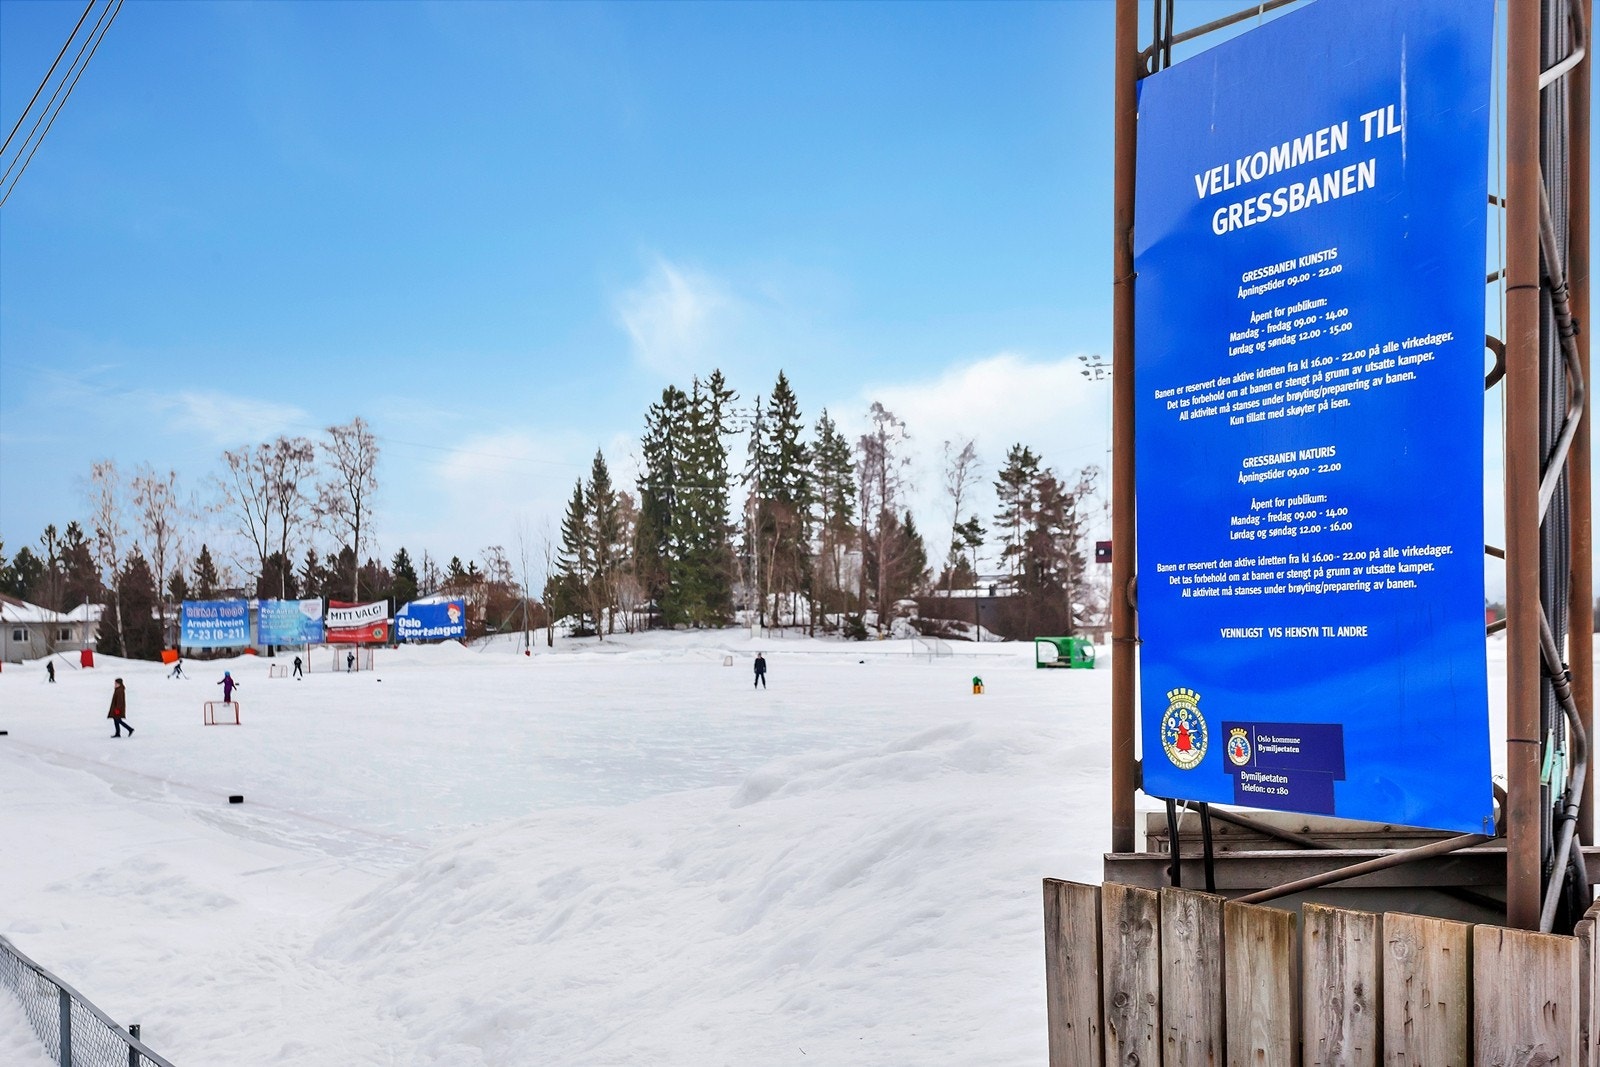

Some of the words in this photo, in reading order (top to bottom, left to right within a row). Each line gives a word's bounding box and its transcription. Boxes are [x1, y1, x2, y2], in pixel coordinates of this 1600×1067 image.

[1194, 121, 1348, 199] VELKOMMEN
[1360, 104, 1402, 143] TIL
[1212, 158, 1375, 235] GRESSBANEN
[1242, 259, 1296, 282] GRESSBANEN
[1299, 248, 1338, 268] KUNSTIS
[1238, 279, 1285, 299] Åpningstider
[1287, 273, 1310, 286] 09.00
[1318, 264, 1342, 277] 22.00
[1250, 310, 1272, 324] Åpent
[1274, 307, 1286, 317] for
[1287, 298, 1327, 317] publikum:
[1230, 328, 1260, 342] Mandag
[1267, 321, 1292, 333] fredag
[1294, 315, 1317, 328] 09.00
[1325, 308, 1348, 321] 14.00
[1229, 344, 1254, 356] Lørdag
[1256, 341, 1266, 351] og
[1268, 334, 1296, 348] søndag
[1299, 329, 1321, 341] 12.00
[1329, 322, 1352, 335] 15.00
[1155, 389, 1175, 399] Banen
[1185, 379, 1216, 393] reservert
[1217, 376, 1230, 386] den
[1232, 372, 1254, 383] aktive
[1256, 366, 1285, 378] idretten
[1287, 362, 1298, 372] fra
[1300, 359, 1308, 370] kl
[1311, 356, 1333, 368] 16.00
[1342, 350, 1366, 362] 22.00
[1369, 344, 1380, 359] på
[1382, 341, 1399, 353] alle
[1402, 332, 1454, 349] virkedager.
[1167, 400, 1178, 410] Det
[1180, 399, 1190, 407] tas
[1192, 390, 1225, 405] forbehold
[1226, 390, 1238, 398] om
[1240, 386, 1248, 396] at
[1250, 383, 1272, 394] banen
[1275, 381, 1283, 389] er
[1285, 374, 1310, 387] stengt
[1312, 370, 1323, 385] på
[1325, 368, 1349, 382] grunn
[1352, 365, 1362, 375] av
[1365, 358, 1395, 372] utsatte
[1398, 352, 1435, 366] kamper.
[1179, 410, 1189, 421] All
[1190, 406, 1218, 419] aktivitet
[1219, 402, 1230, 414] må
[1232, 400, 1260, 411] stanses
[1262, 394, 1284, 406] under
[1286, 379, 1370, 402] brøyting/preparering
[1372, 377, 1383, 386] av
[1386, 372, 1416, 384] banen.
[1230, 416, 1244, 426] Kun
[1246, 411, 1266, 423] tillatt
[1268, 407, 1284, 419] med
[1286, 404, 1316, 416] skøyter
[1318, 399, 1328, 413] på
[1331, 398, 1351, 408] isen.
[1243, 451, 1296, 468] GRESSBANEN
[1299, 446, 1336, 460] NATURIS
[1238, 468, 1285, 484] Åpningstider
[1287, 467, 1310, 478] 09.00
[1318, 463, 1341, 473] 22.00
[1251, 498, 1273, 512] Åpent
[1275, 497, 1286, 507] for
[1288, 494, 1327, 508] publikum:
[1231, 514, 1260, 526] Mandag
[1267, 511, 1292, 523] fredag
[1294, 510, 1317, 522] 09.00
[1326, 507, 1348, 518] 14.00
[1230, 529, 1255, 540] Lørdag
[1257, 530, 1267, 539] og
[1269, 525, 1297, 537] søndag
[1299, 525, 1321, 534] 12.00
[1330, 521, 1352, 531] 16.00
[1157, 563, 1177, 572] Banen
[1187, 560, 1217, 570] reservert
[1219, 559, 1232, 568] den
[1234, 557, 1256, 567] aktive
[1258, 556, 1286, 566] idretten
[1289, 554, 1299, 564] fra
[1302, 553, 1310, 563] kl
[1312, 552, 1336, 562] 16.00
[1342, 552, 1366, 560] 22.00
[1369, 548, 1380, 561] på
[1383, 547, 1399, 558] alle
[1402, 544, 1453, 557] virkedager.
[1169, 576, 1181, 584] Det
[1182, 576, 1192, 584] tas
[1194, 572, 1226, 583] forbehold
[1228, 574, 1240, 582] om
[1242, 572, 1250, 581] at
[1251, 571, 1274, 580] banen
[1276, 571, 1285, 579] er
[1286, 568, 1311, 580] stengt
[1314, 566, 1324, 579] på
[1326, 568, 1350, 579] grunn
[1353, 567, 1363, 575] av
[1366, 564, 1396, 574] utsatte
[1398, 562, 1435, 574] kamper.
[1182, 588, 1191, 597] All
[1192, 587, 1220, 597] aktivitet
[1222, 586, 1233, 596] må
[1234, 586, 1262, 595] stanses
[1264, 584, 1286, 594] under
[1288, 580, 1371, 595] brøyting/preparering
[1373, 581, 1384, 590] av
[1387, 578, 1417, 589] banen.
[186, 607, 218, 618] REMA
[220, 606, 245, 617] 1000
[330, 611, 353, 620] MITT
[356, 605, 382, 619] VALG!
[187, 618, 244, 628] Arnebråtveien
[398, 617, 421, 628] Oslo
[398, 624, 463, 638] Sportslager
[1220, 628, 1264, 638] VENNLIGST
[1268, 627, 1282, 638] VIS
[1285, 627, 1319, 637] HENSYN
[1322, 626, 1335, 637] TIL
[1337, 626, 1368, 637] ANDRE
[187, 629, 211, 640] 7-23
[213, 628, 245, 640] (8-21)
[1257, 735, 1270, 744] Oslo
[1271, 736, 1300, 744] kommune
[1258, 745, 1300, 754] Bymiljøetaten
[1241, 771, 1288, 783] Bymiljøetaten
[1241, 783, 1266, 793] Telefon:
[1276, 787, 1288, 795] 180
